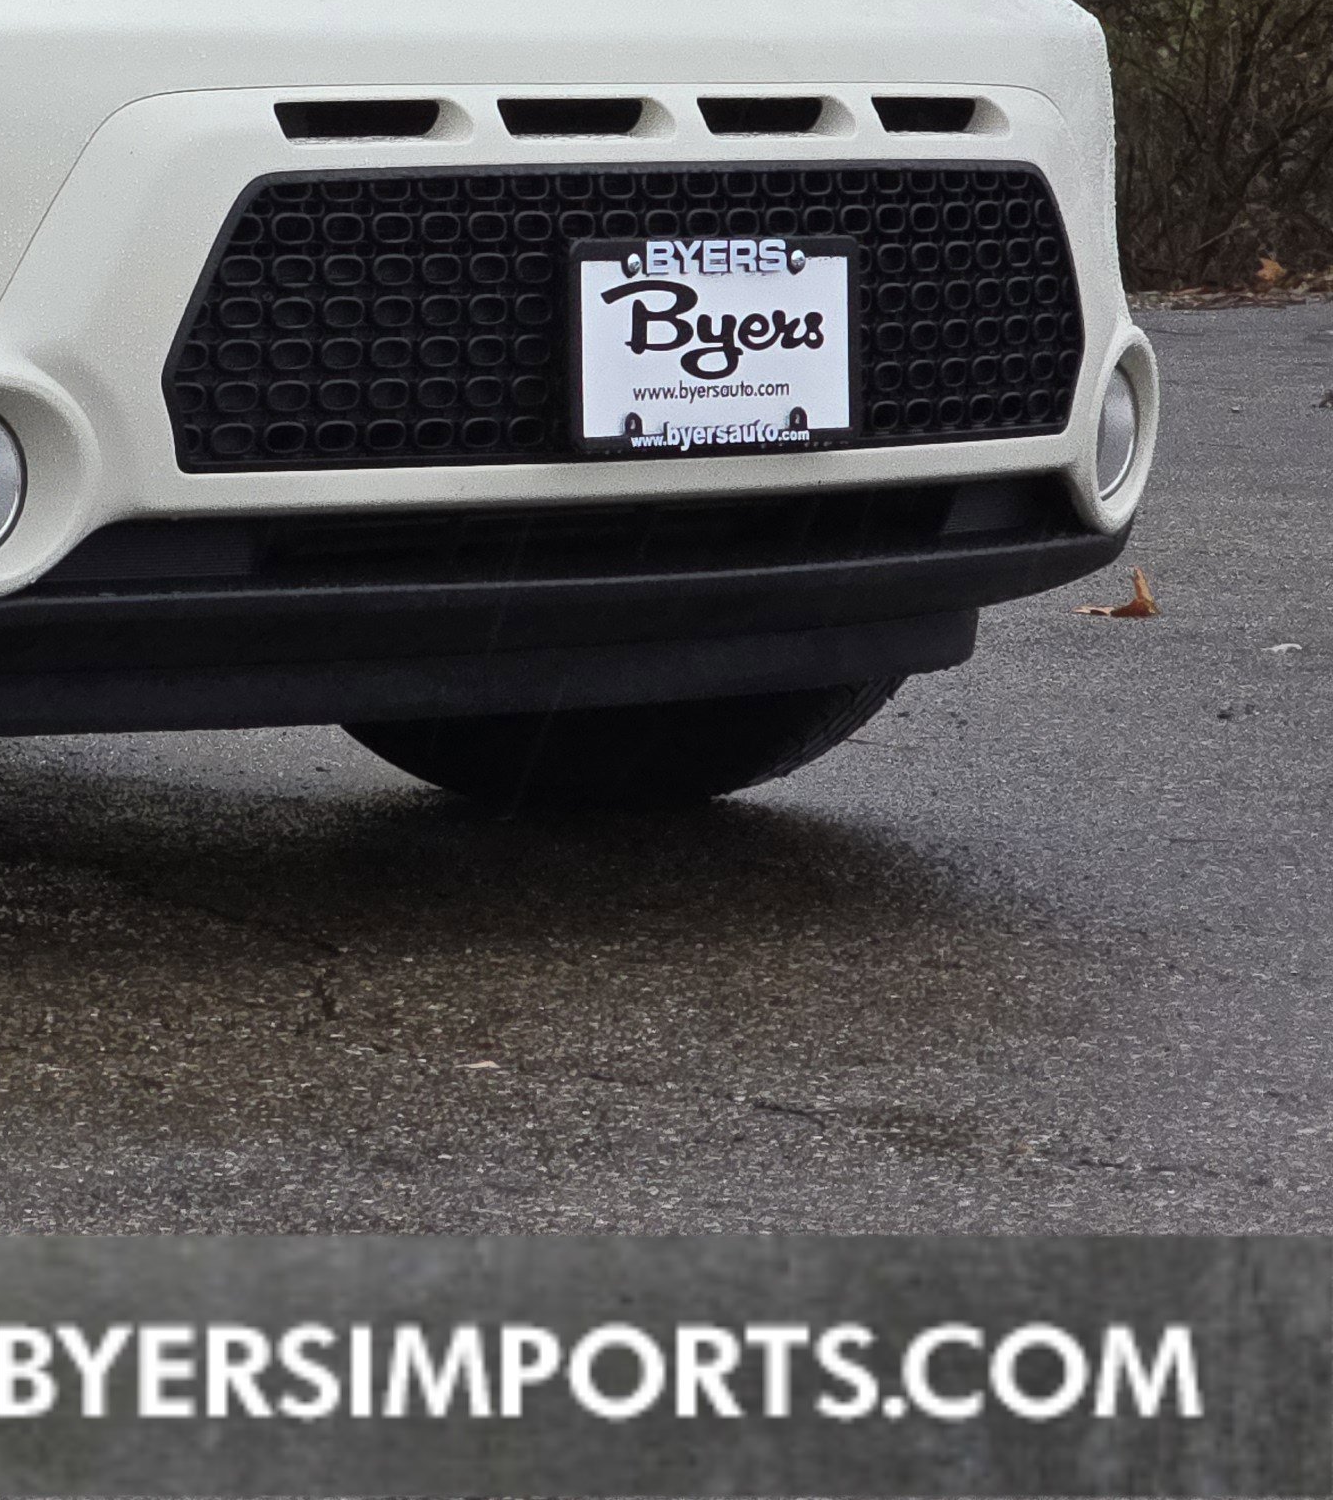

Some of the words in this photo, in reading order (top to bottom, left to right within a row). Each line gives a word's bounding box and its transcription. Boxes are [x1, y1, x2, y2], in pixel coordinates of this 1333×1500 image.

[645, 238, 787, 275] BYERS
[599, 279, 825, 380] Byers
[632, 380, 791, 404] www.byersauto.com
[630, 420, 810, 451] www.byersauto.com
